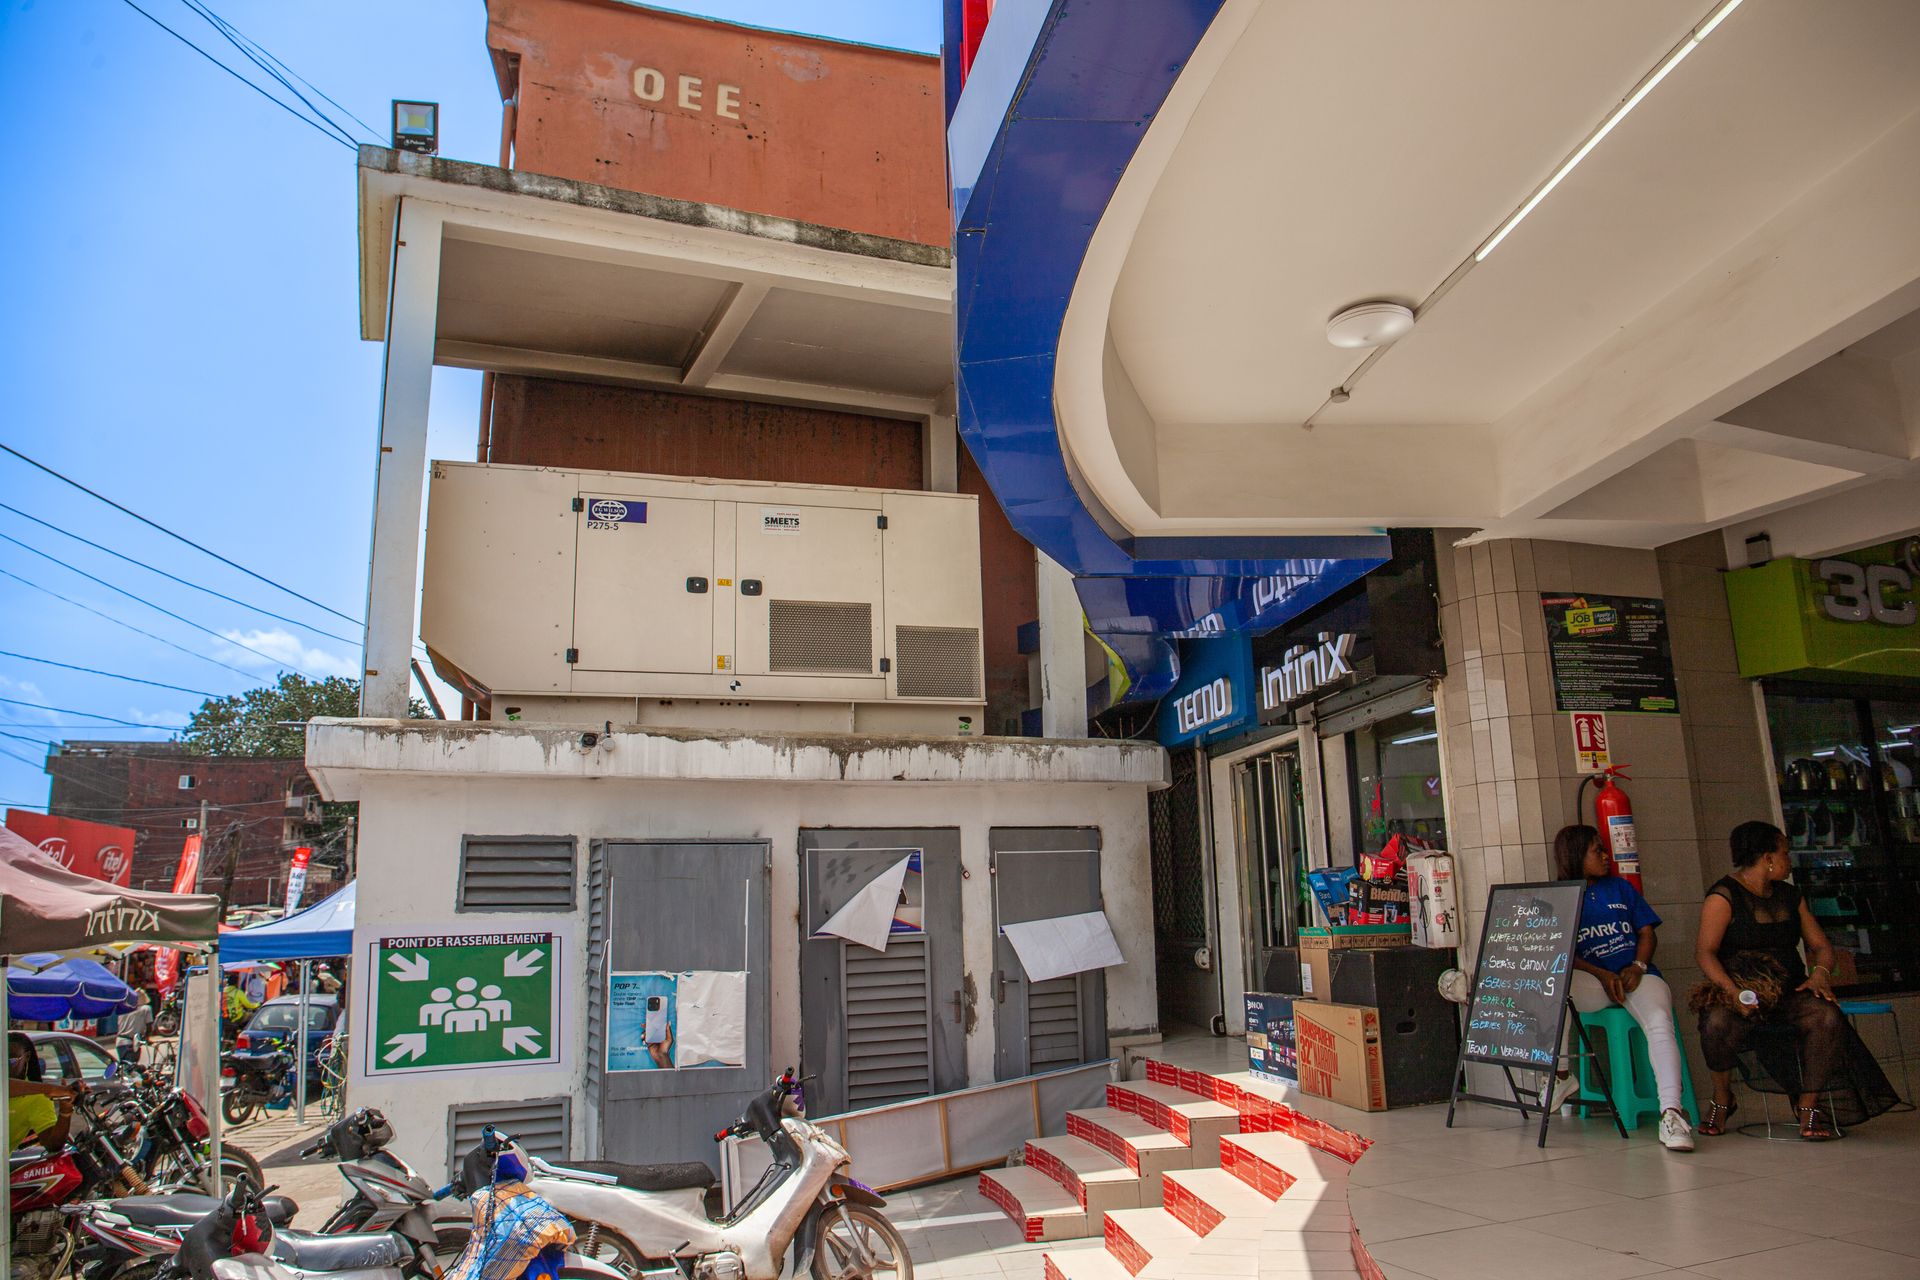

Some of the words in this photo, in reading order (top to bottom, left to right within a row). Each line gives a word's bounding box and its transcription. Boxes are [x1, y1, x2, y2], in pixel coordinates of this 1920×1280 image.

[587, 522, 619, 531] P275-5
[764, 517, 800, 525] SMEETS
[1812, 560, 1918, 625] 3C
[1570, 614, 1591, 624] JOB
[1261, 632, 1357, 710] Infinix
[1173, 677, 1232, 734] TECNO
[103, 850, 123, 870] itel
[85, 900, 160, 937] Infinix
[388, 937, 425, 949] POINT
[427, 936, 443, 947] DE
[445, 934, 546, 947] RASSEMBLEMENT
[1551, 952, 1568, 974] 19
[1513, 978, 1543, 993] SPARK
[1543, 976, 1555, 996] 9
[1298, 1014, 1336, 1051] TRANSPARENT
[1466, 1040, 1488, 1055] TECNO
[23, 1166, 54, 1179] SANILI
